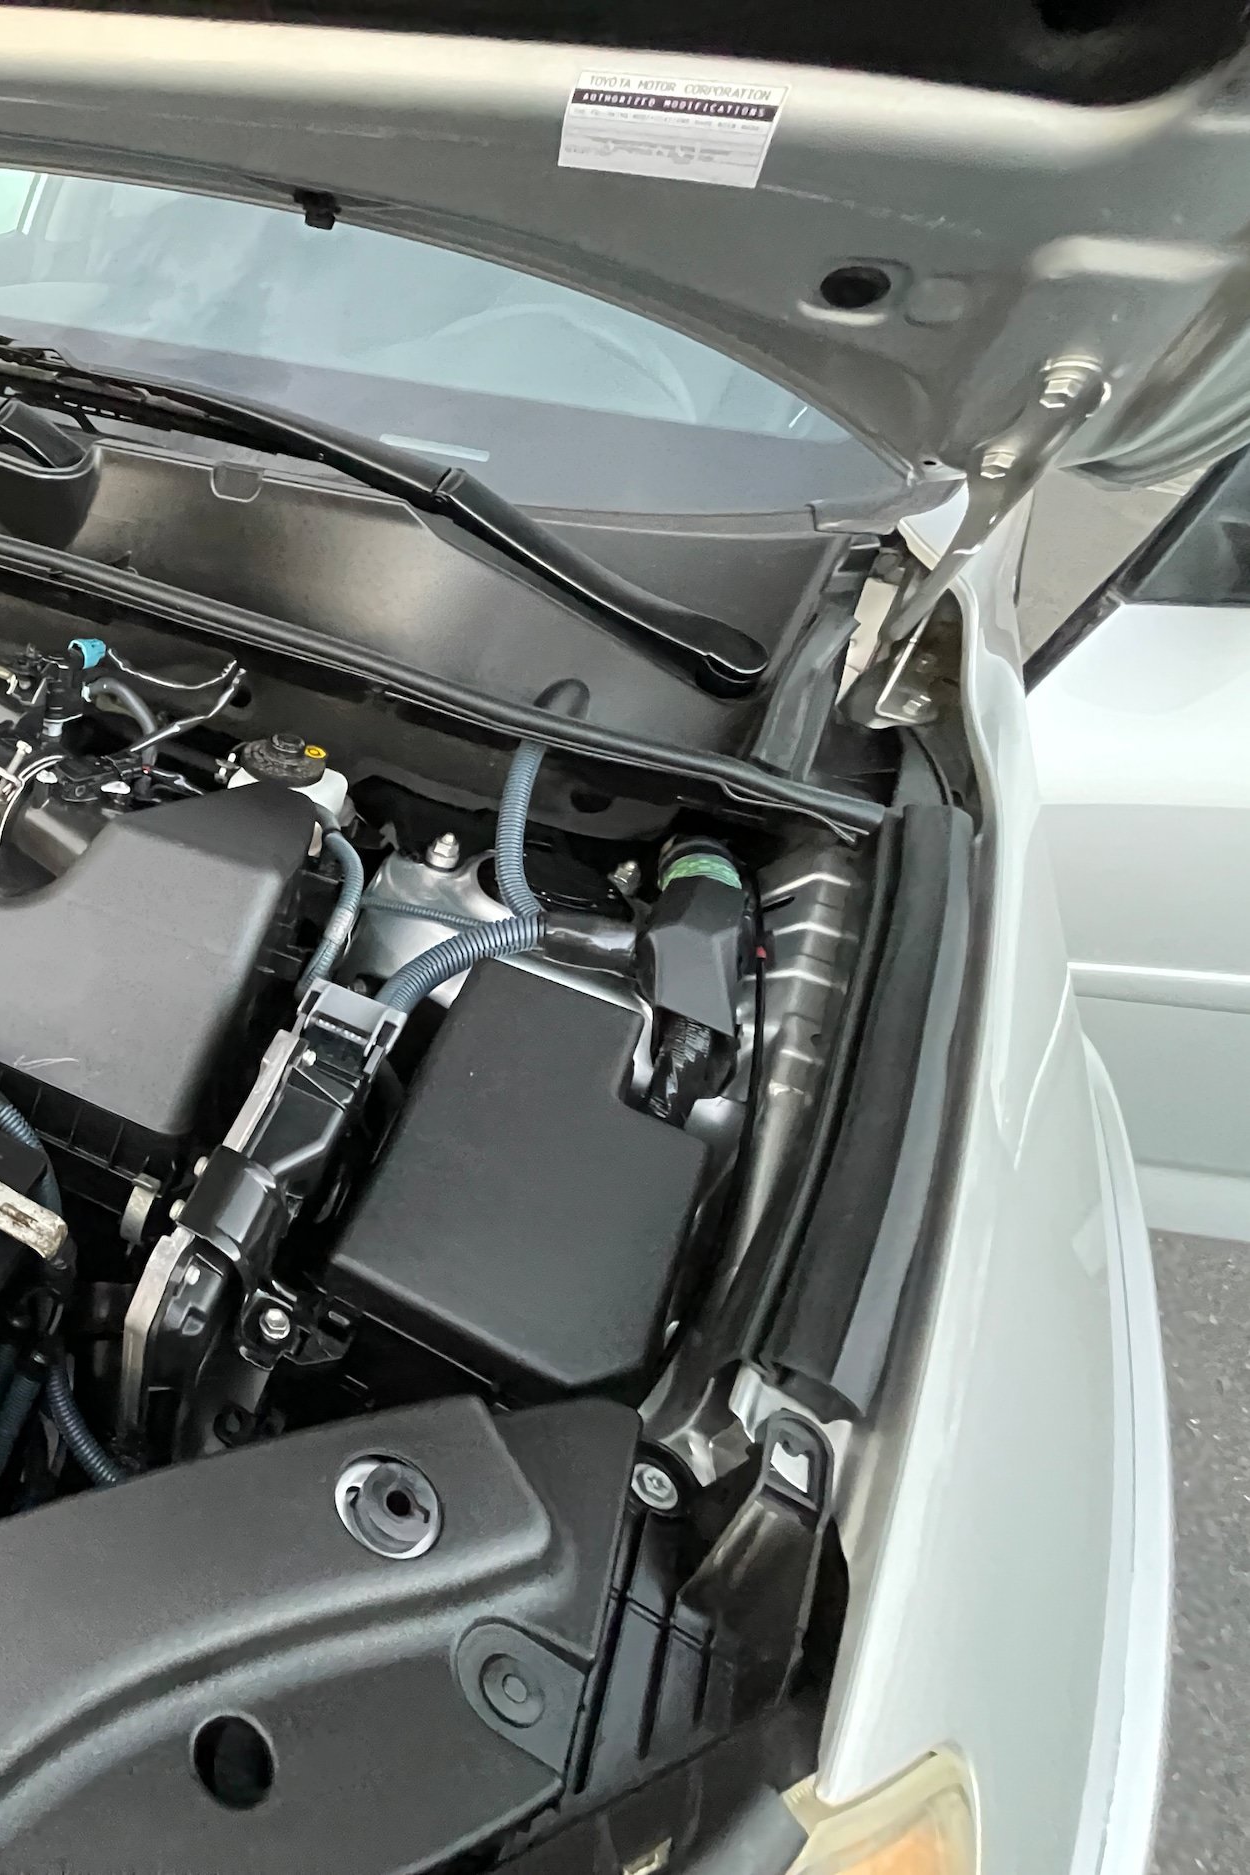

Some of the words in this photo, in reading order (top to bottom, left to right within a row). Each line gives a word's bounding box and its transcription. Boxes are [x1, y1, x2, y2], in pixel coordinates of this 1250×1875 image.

[590, 75, 631, 88] TOYOTA
[639, 80, 676, 91] MOTOR
[684, 84, 772, 100] CORPORATION
[582, 92, 656, 108] AUTHORIZED
[663, 98, 766, 117] MODIFICATIONS
